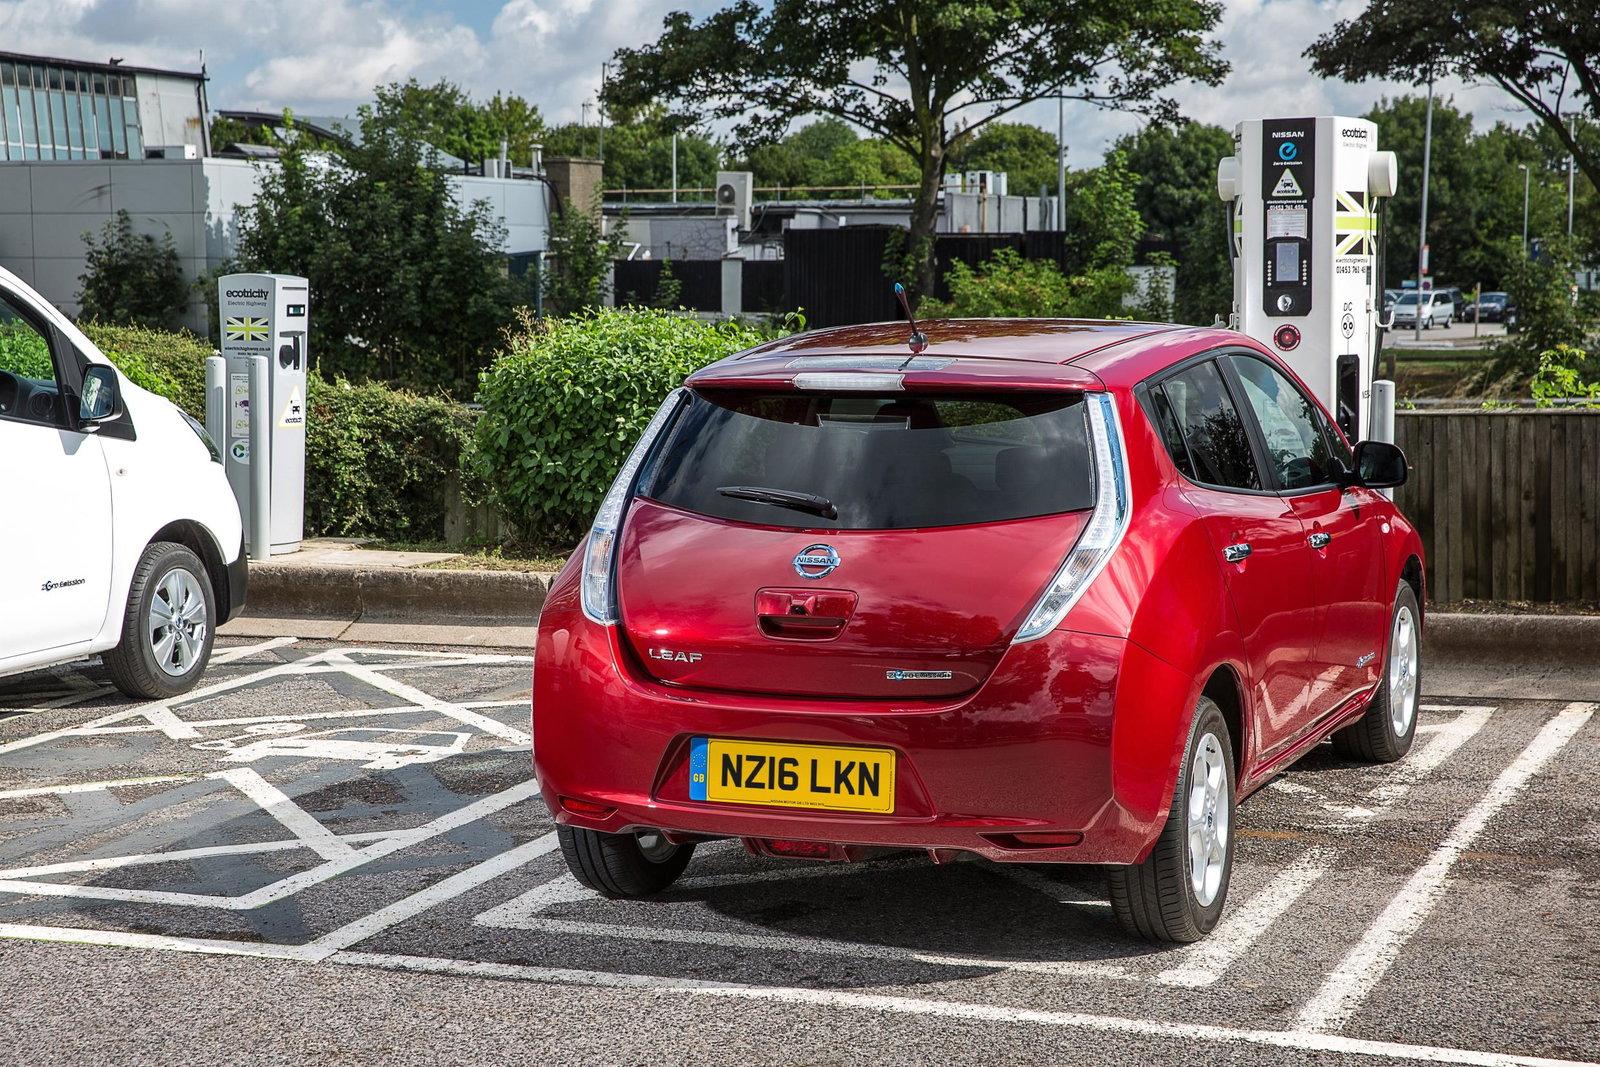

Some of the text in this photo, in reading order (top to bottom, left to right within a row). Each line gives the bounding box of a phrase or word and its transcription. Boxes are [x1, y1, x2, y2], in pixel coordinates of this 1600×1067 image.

[226, 288, 269, 300] ecotricity
[796, 556, 835, 564] NISSAN
[648, 648, 703, 663] LEAF
[693, 773, 704, 783] GB
[721, 753, 799, 791] NZ16
[810, 759, 880, 797] LKN
